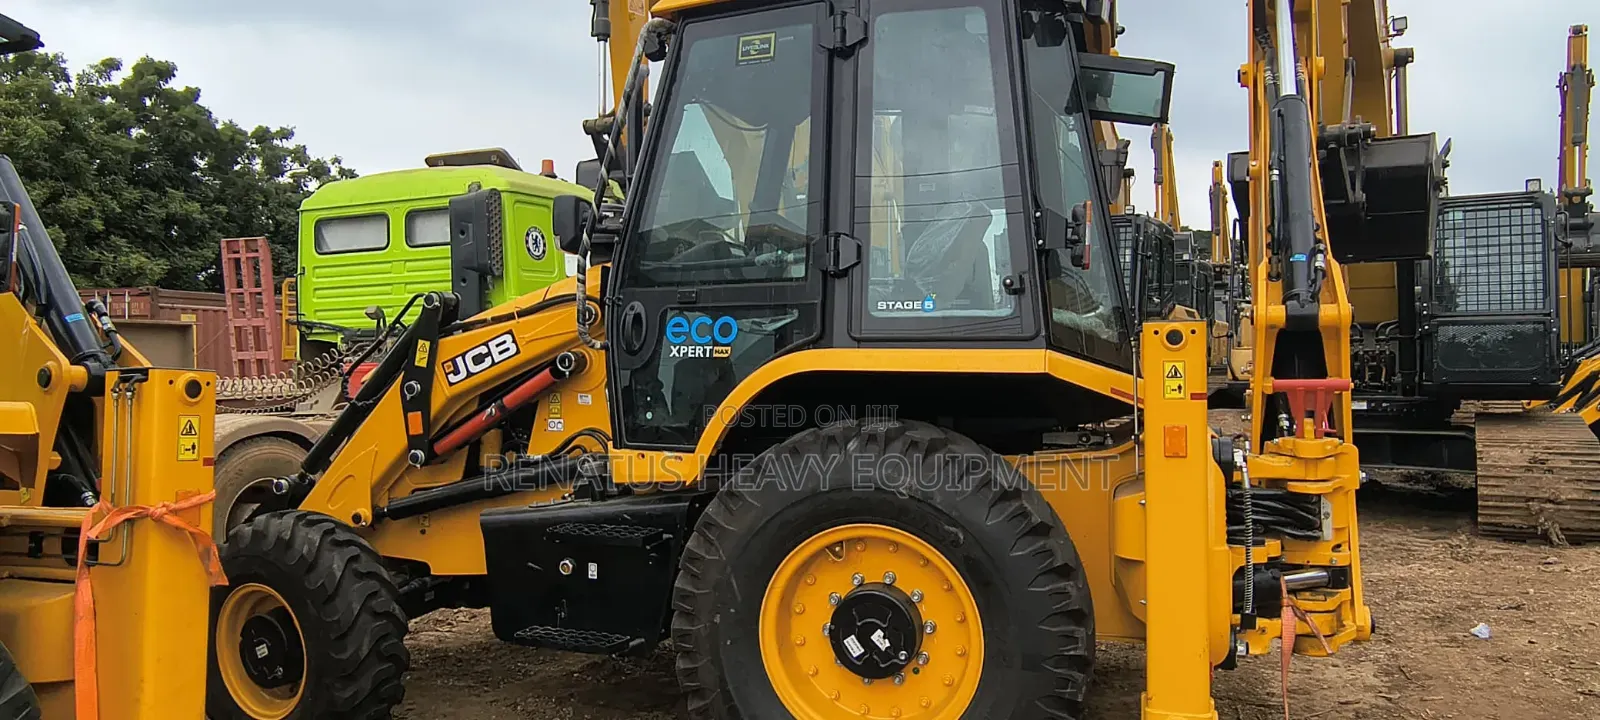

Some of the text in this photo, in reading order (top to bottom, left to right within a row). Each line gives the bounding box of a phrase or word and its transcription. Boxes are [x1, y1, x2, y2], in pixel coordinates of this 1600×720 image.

[877, 300, 934, 310] STAGE 5
[666, 316, 738, 345] eco
[447, 333, 517, 383] JCB
[669, 345, 713, 358] XPERT
